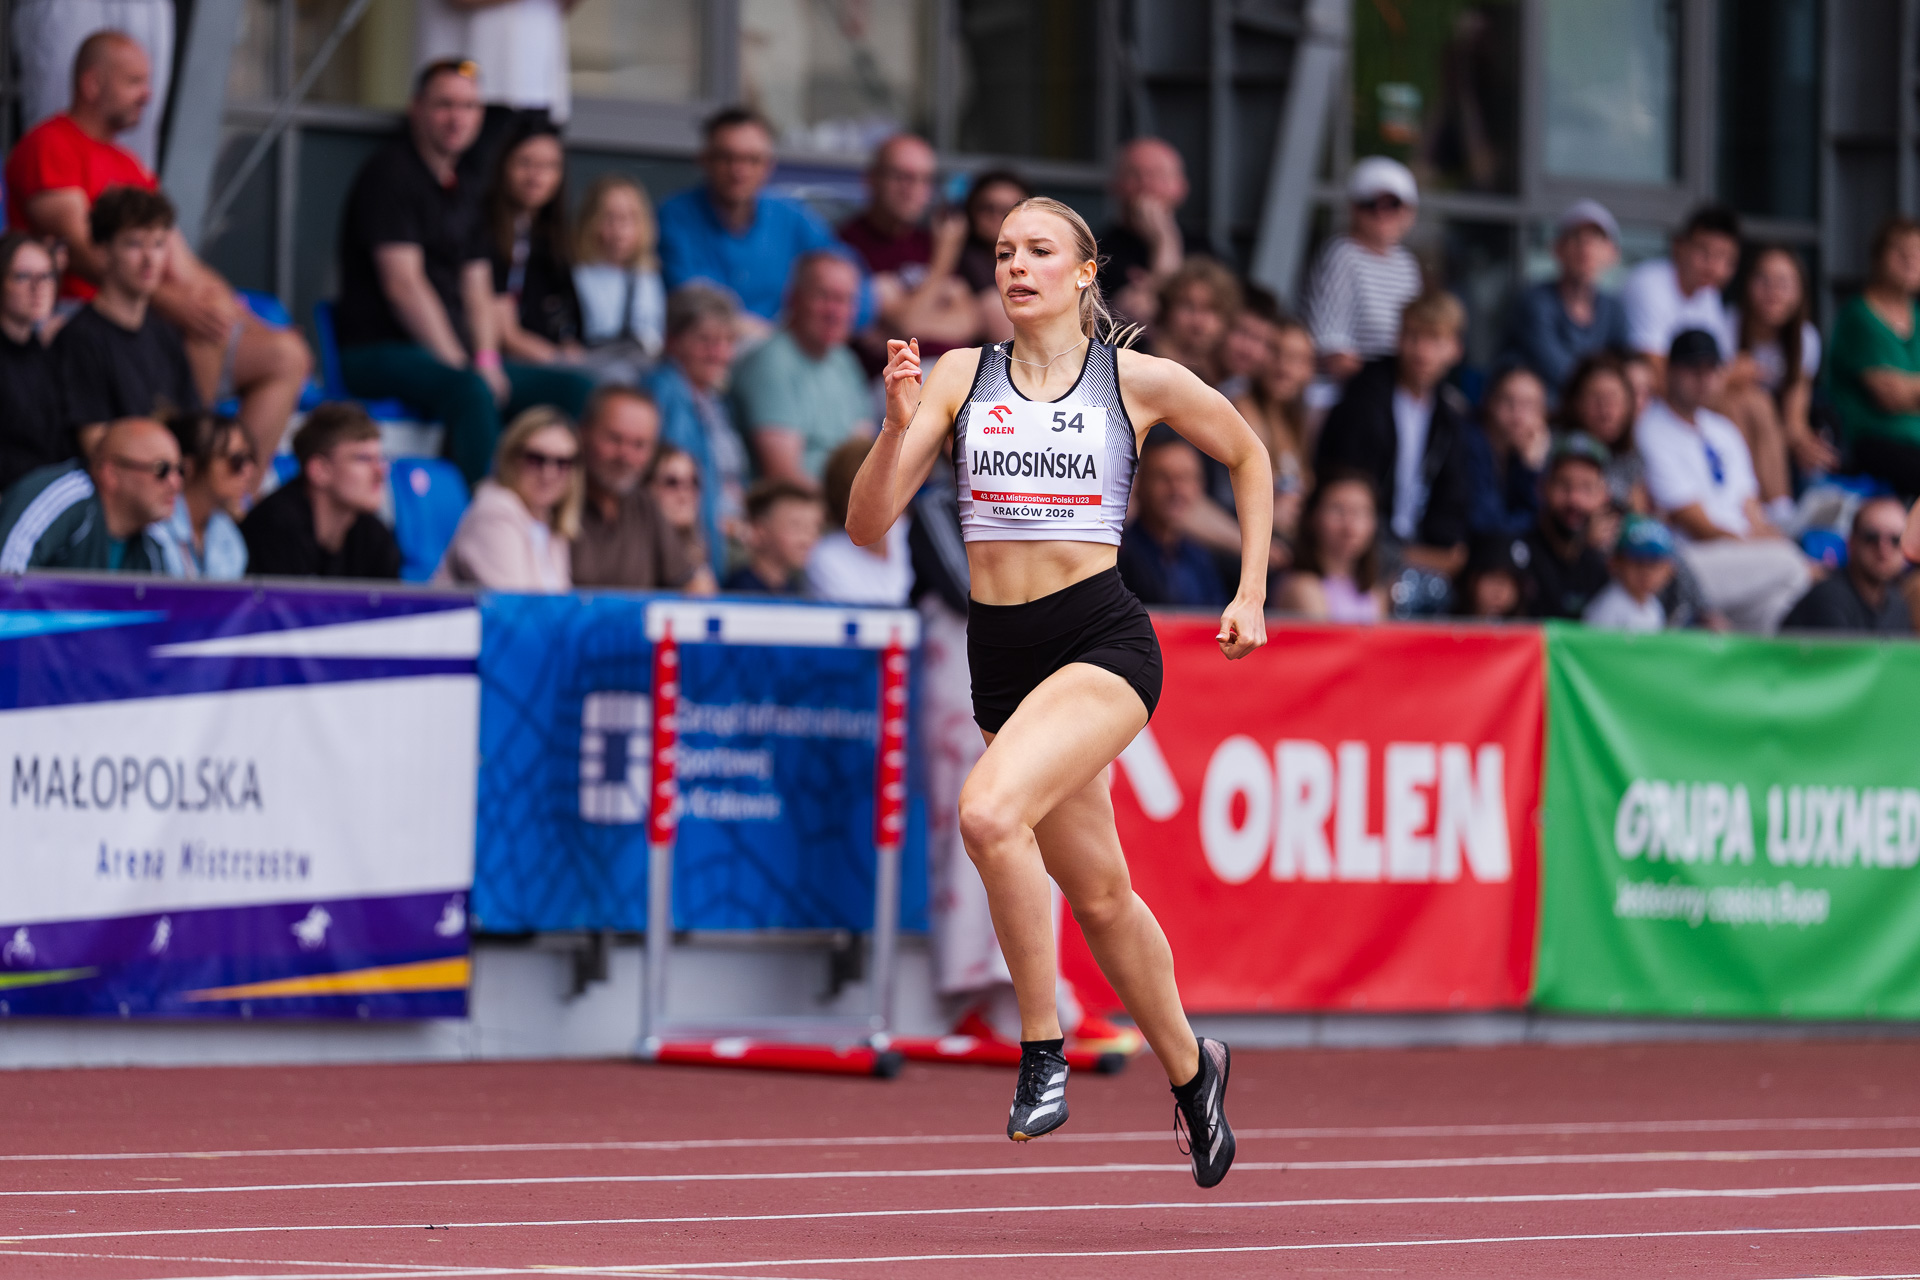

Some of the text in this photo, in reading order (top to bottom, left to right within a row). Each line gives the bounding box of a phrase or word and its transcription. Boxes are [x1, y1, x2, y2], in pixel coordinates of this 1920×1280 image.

[983, 426, 1015, 435] ORLEN
[1051, 411, 1085, 434] 54
[972, 447, 1097, 480] JAROSIŃSKA
[990, 494, 1005, 502] PZLA
[1005, 494, 1051, 503] Mistrzostwa
[1052, 496, 1075, 504] Polski
[1076, 496, 1090, 504] U23
[992, 505, 1075, 518] KRAKÓW 2026
[10, 754, 264, 811] MAŁOPOLSKA
[1198, 734, 1512, 885] ORLEN
[1615, 778, 1920, 869] GRUPA LUXMED
[95, 838, 312, 880] Arena Mistrzostw
